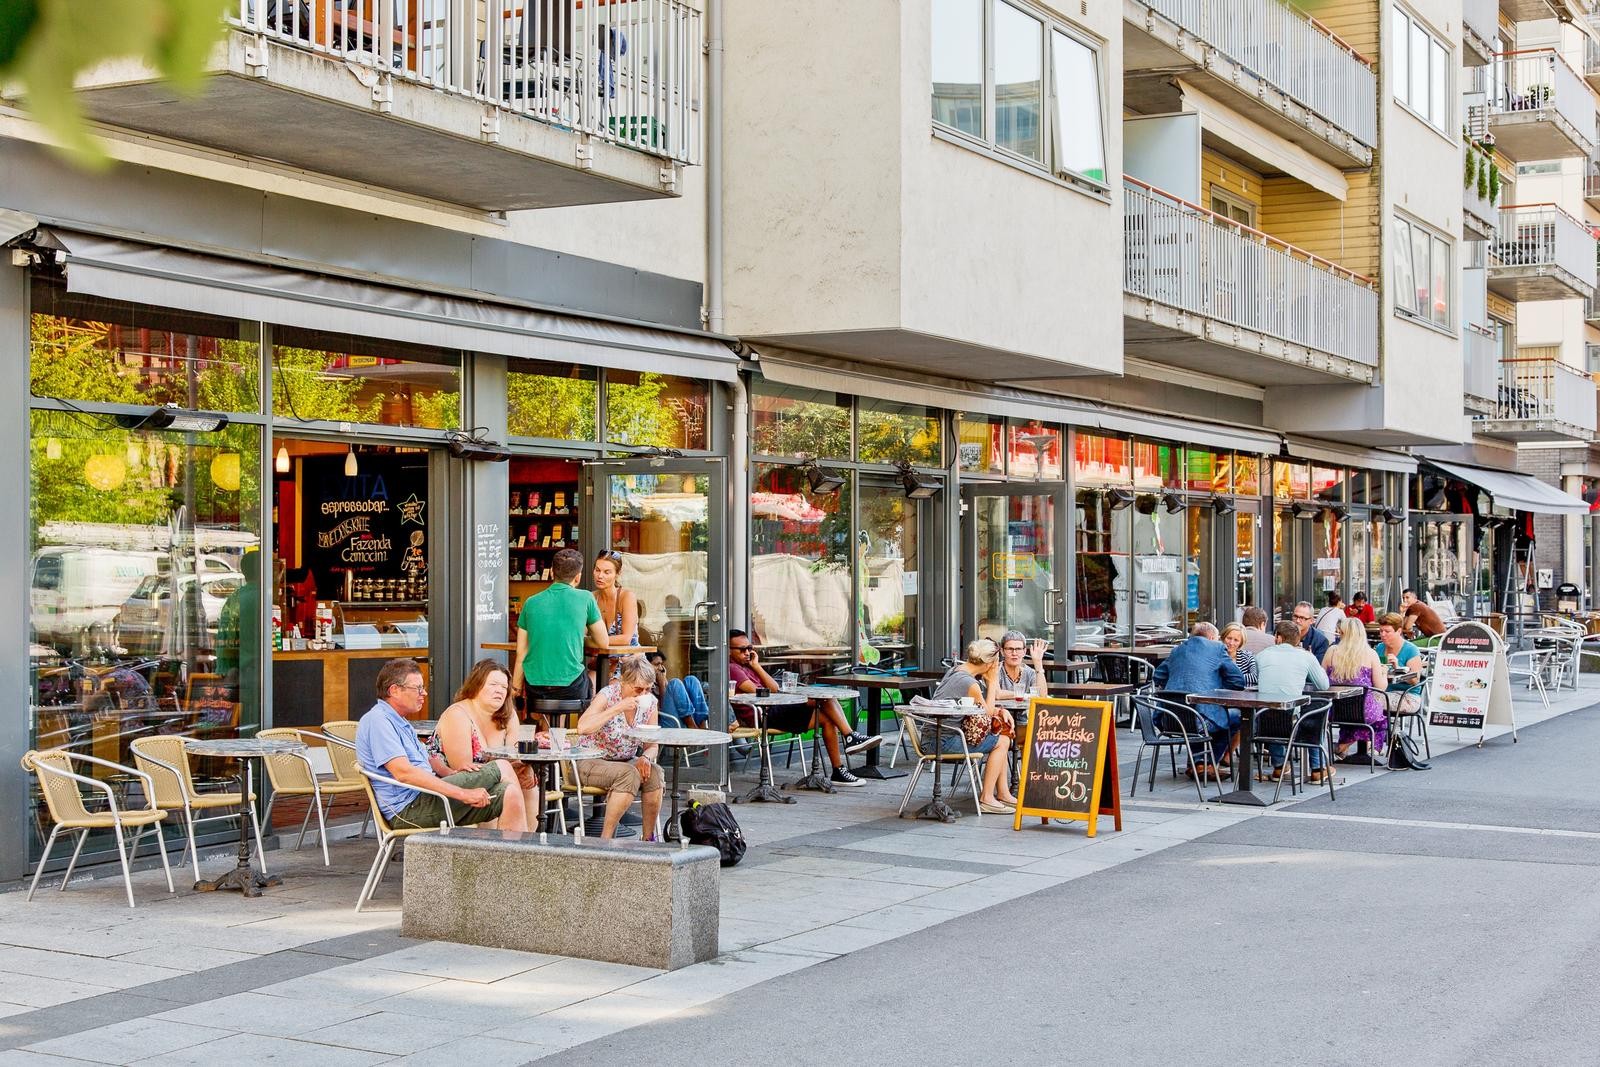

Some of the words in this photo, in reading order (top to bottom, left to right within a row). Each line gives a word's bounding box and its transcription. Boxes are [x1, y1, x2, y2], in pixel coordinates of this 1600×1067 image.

[477, 523, 499, 534] EVITA
[350, 534, 392, 551] Fazenda
[1442, 658, 1489, 668] LUNSJMENY
[1037, 709, 1064, 727] Prøv
[1066, 712, 1087, 727] vår
[1036, 726, 1095, 743] fantastiske
[1035, 741, 1082, 760] VEGGIS
[1047, 757, 1088, 770] Sandwich
[1044, 772, 1059, 781] kun
